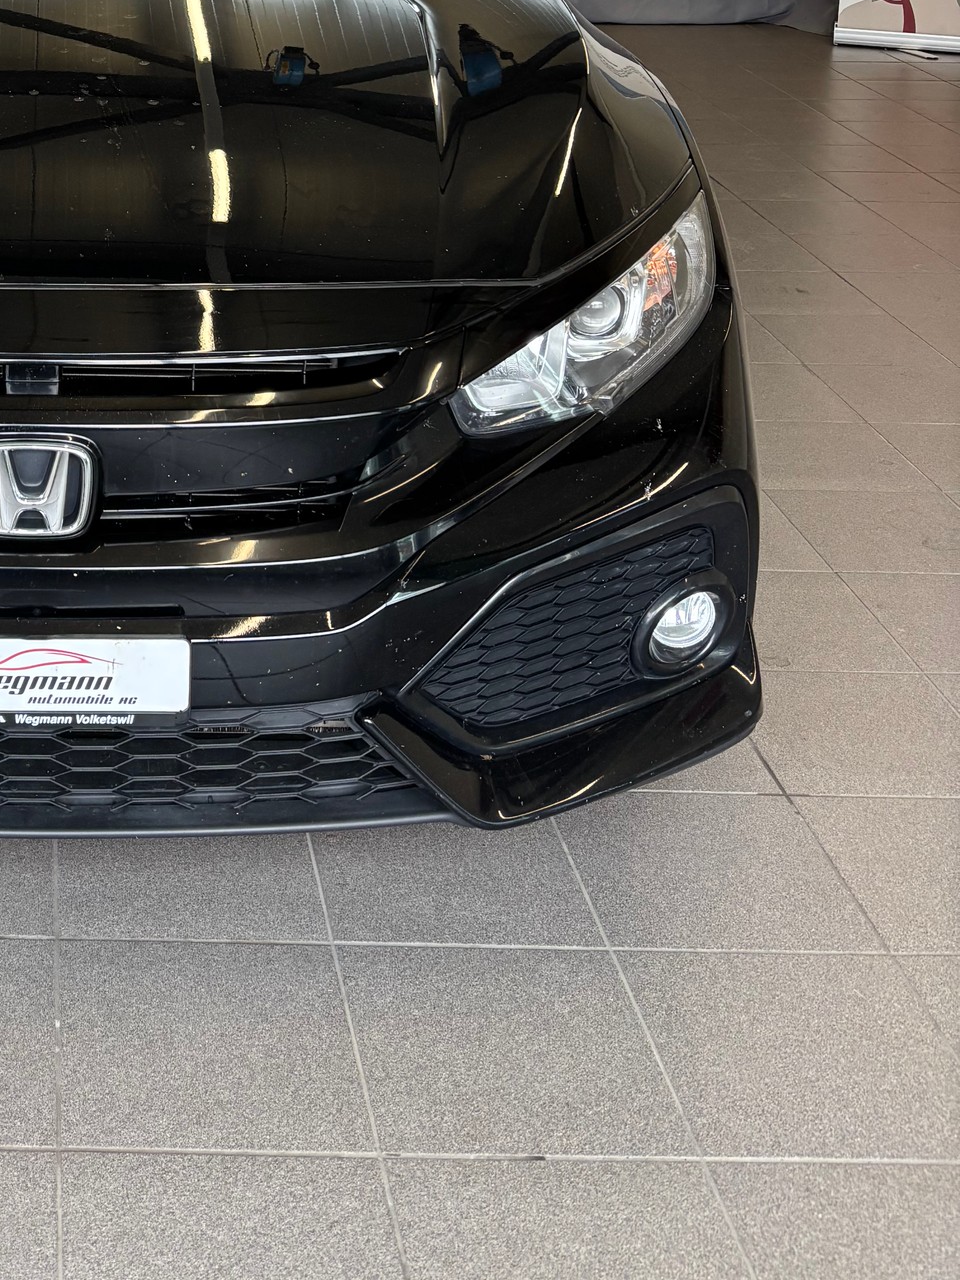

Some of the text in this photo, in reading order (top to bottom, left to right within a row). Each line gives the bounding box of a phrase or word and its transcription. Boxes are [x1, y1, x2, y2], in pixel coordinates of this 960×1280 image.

[27, 694, 113, 705] automobile
[14, 713, 73, 726] Wegmann
[76, 713, 135, 725] Volketswil
